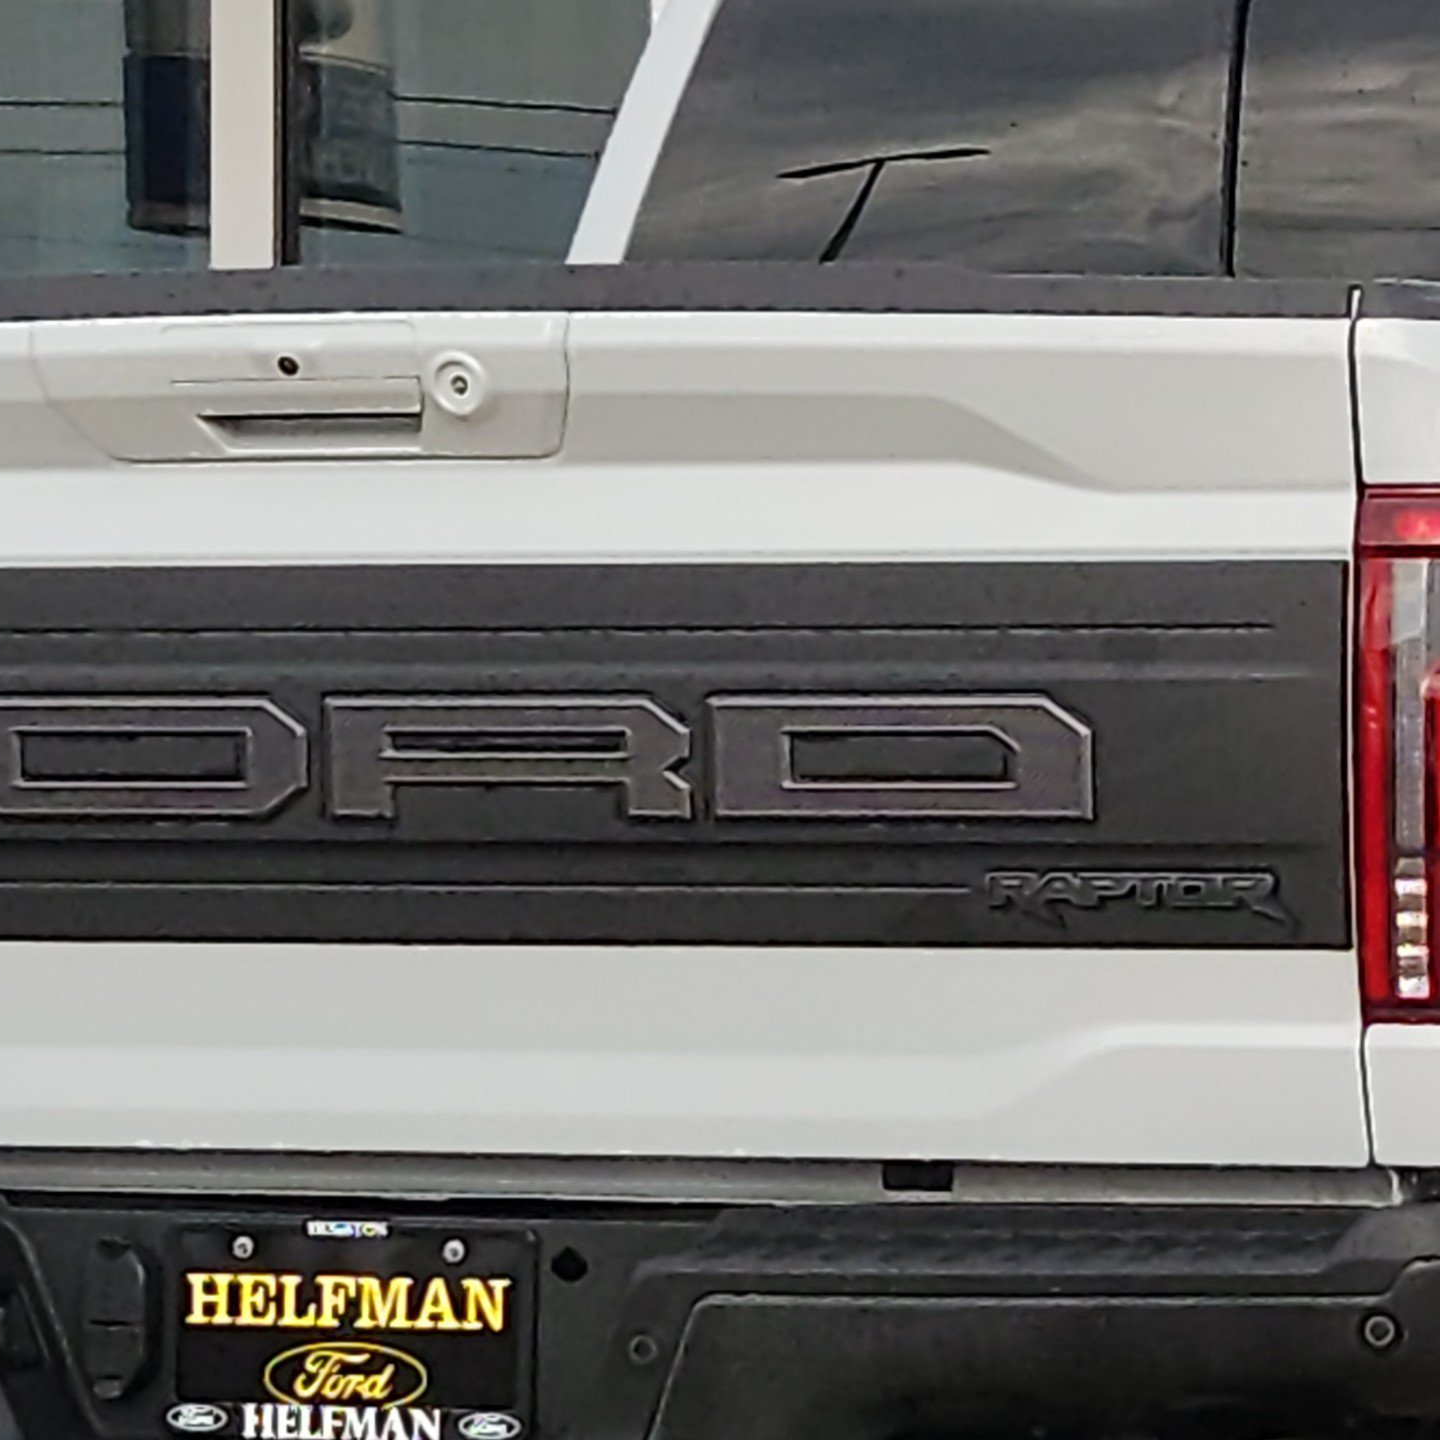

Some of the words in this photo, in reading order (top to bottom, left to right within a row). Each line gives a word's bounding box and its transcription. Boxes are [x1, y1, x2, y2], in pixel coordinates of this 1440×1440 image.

[983, 868, 1304, 933] RAPTOR
[184, 1272, 513, 1333] HELFMAN
[292, 1349, 396, 1400] Ford
